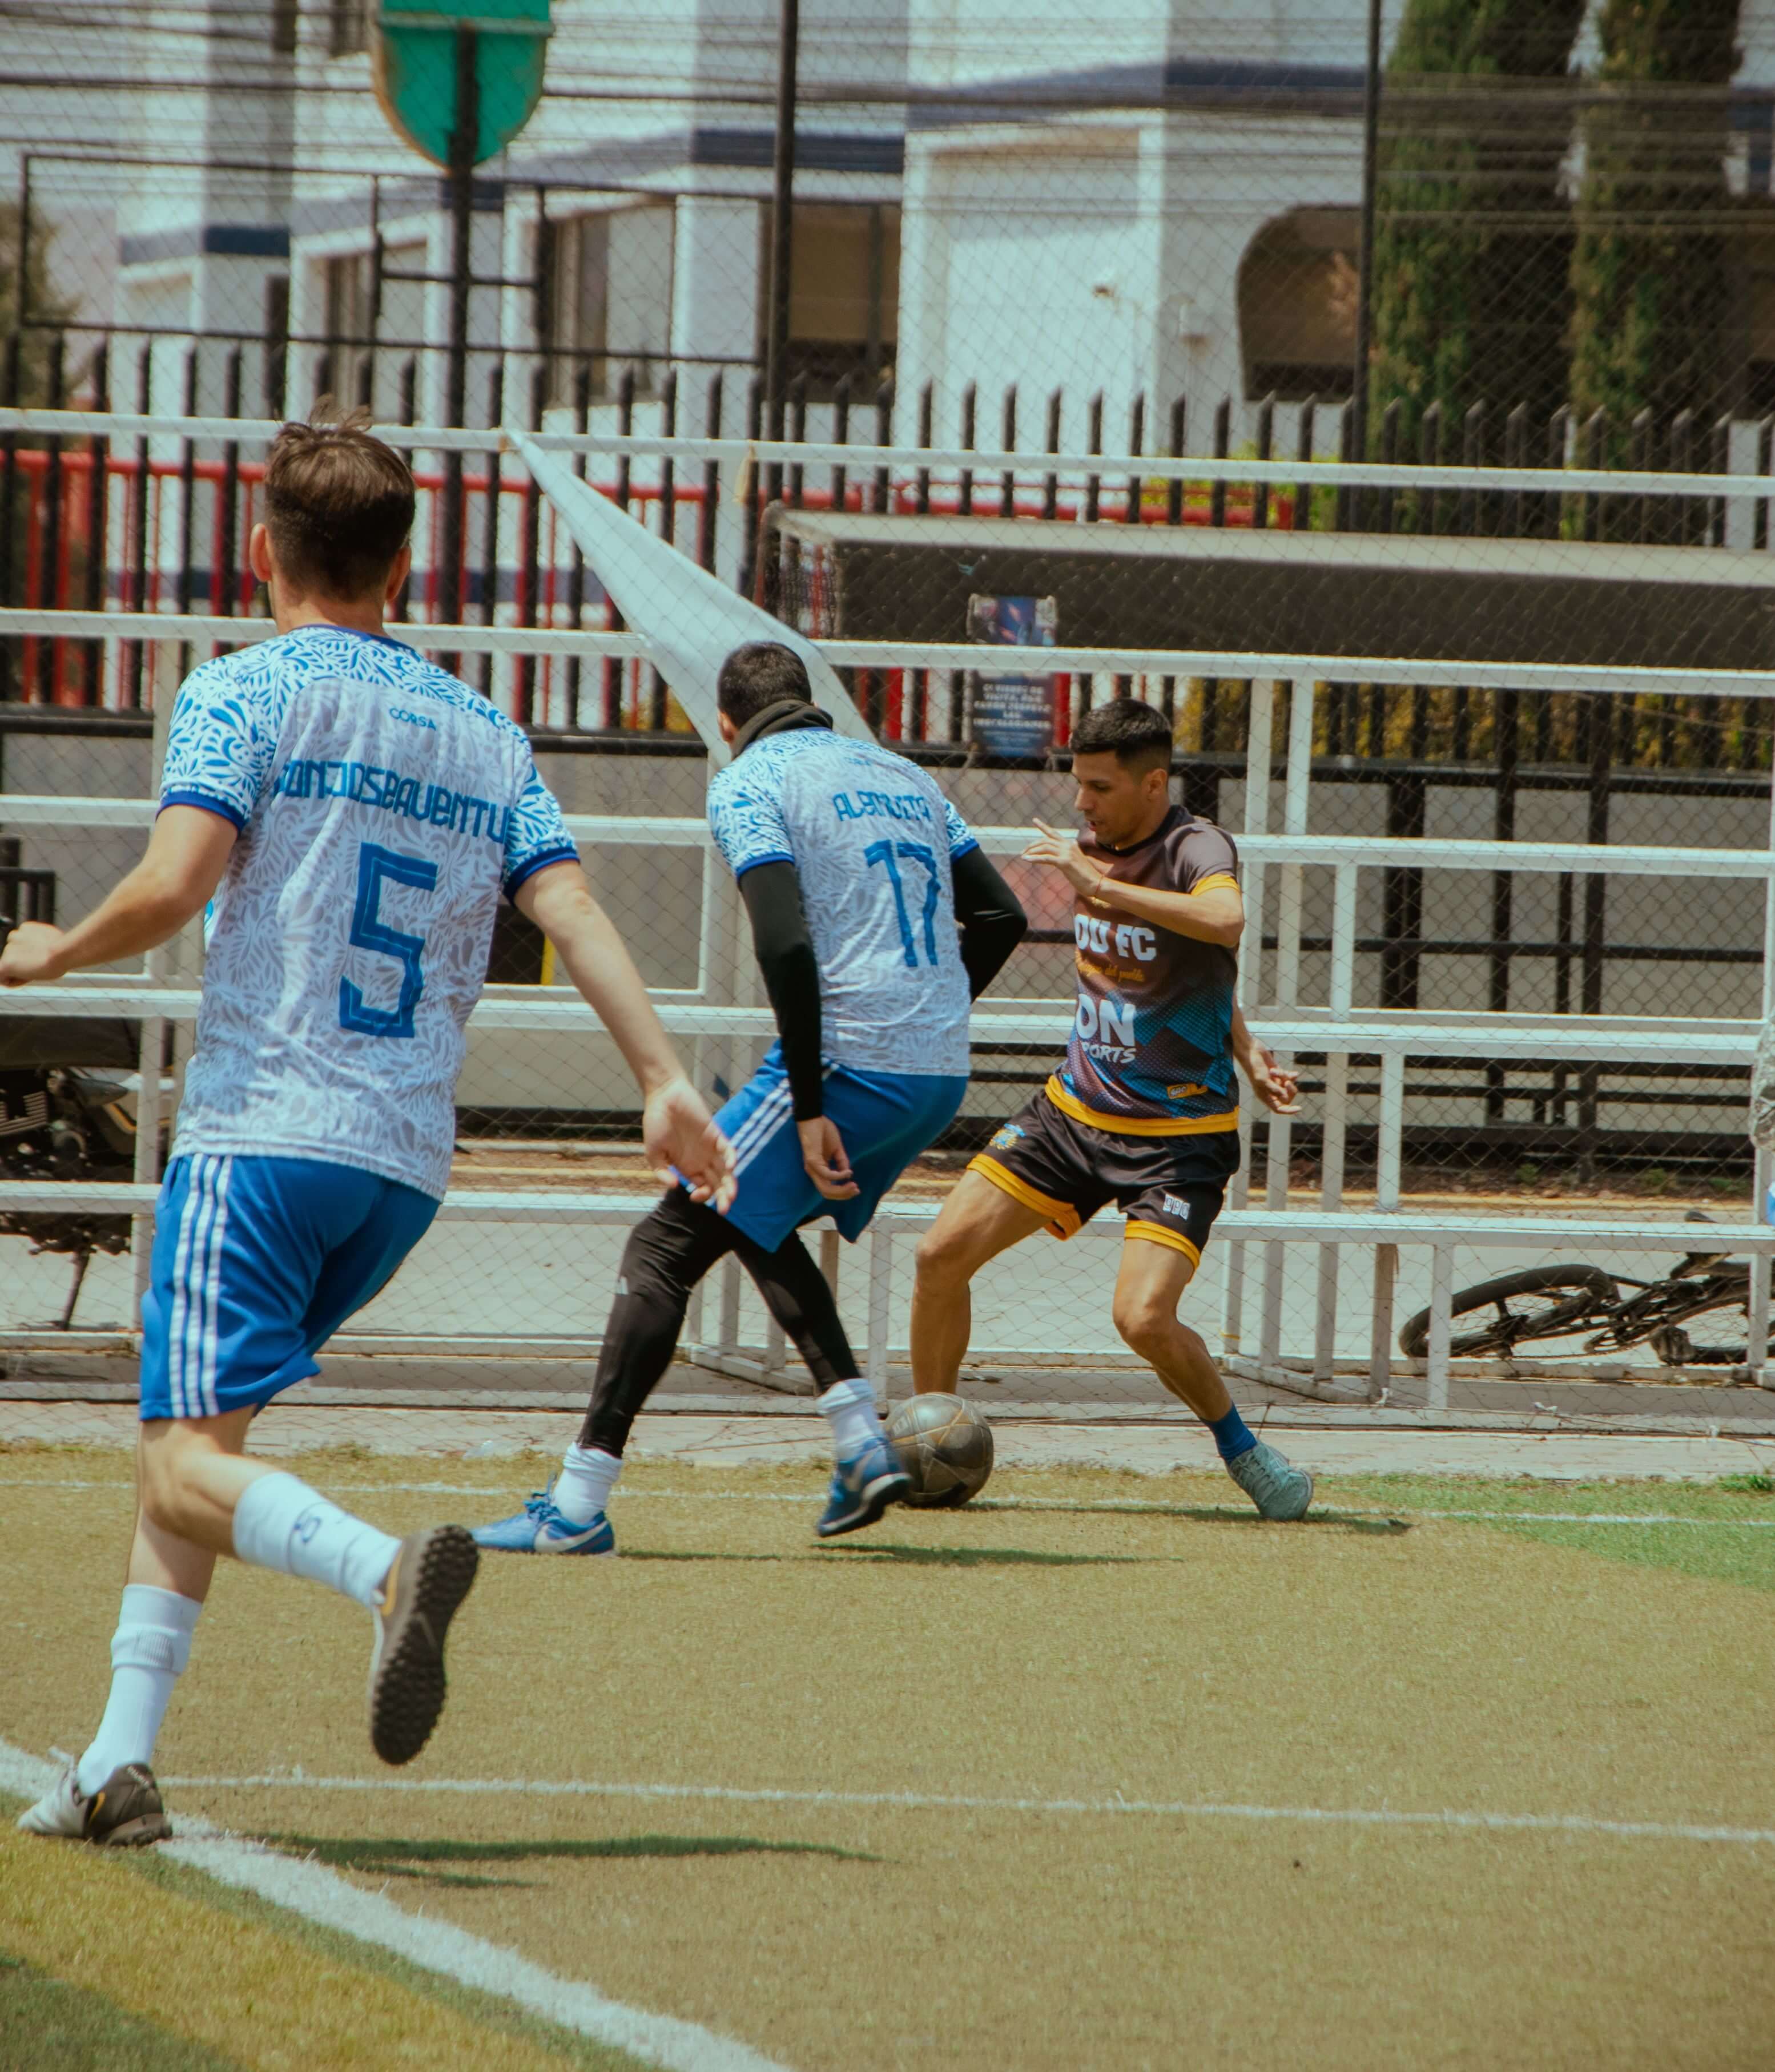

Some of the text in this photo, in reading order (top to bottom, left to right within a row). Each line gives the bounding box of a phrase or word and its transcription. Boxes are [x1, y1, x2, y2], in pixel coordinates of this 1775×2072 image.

[389, 708, 436, 731] CORSA
[339, 841, 438, 1038] 5
[864, 840, 941, 967] 17
[1115, 923, 1157, 961] FC
